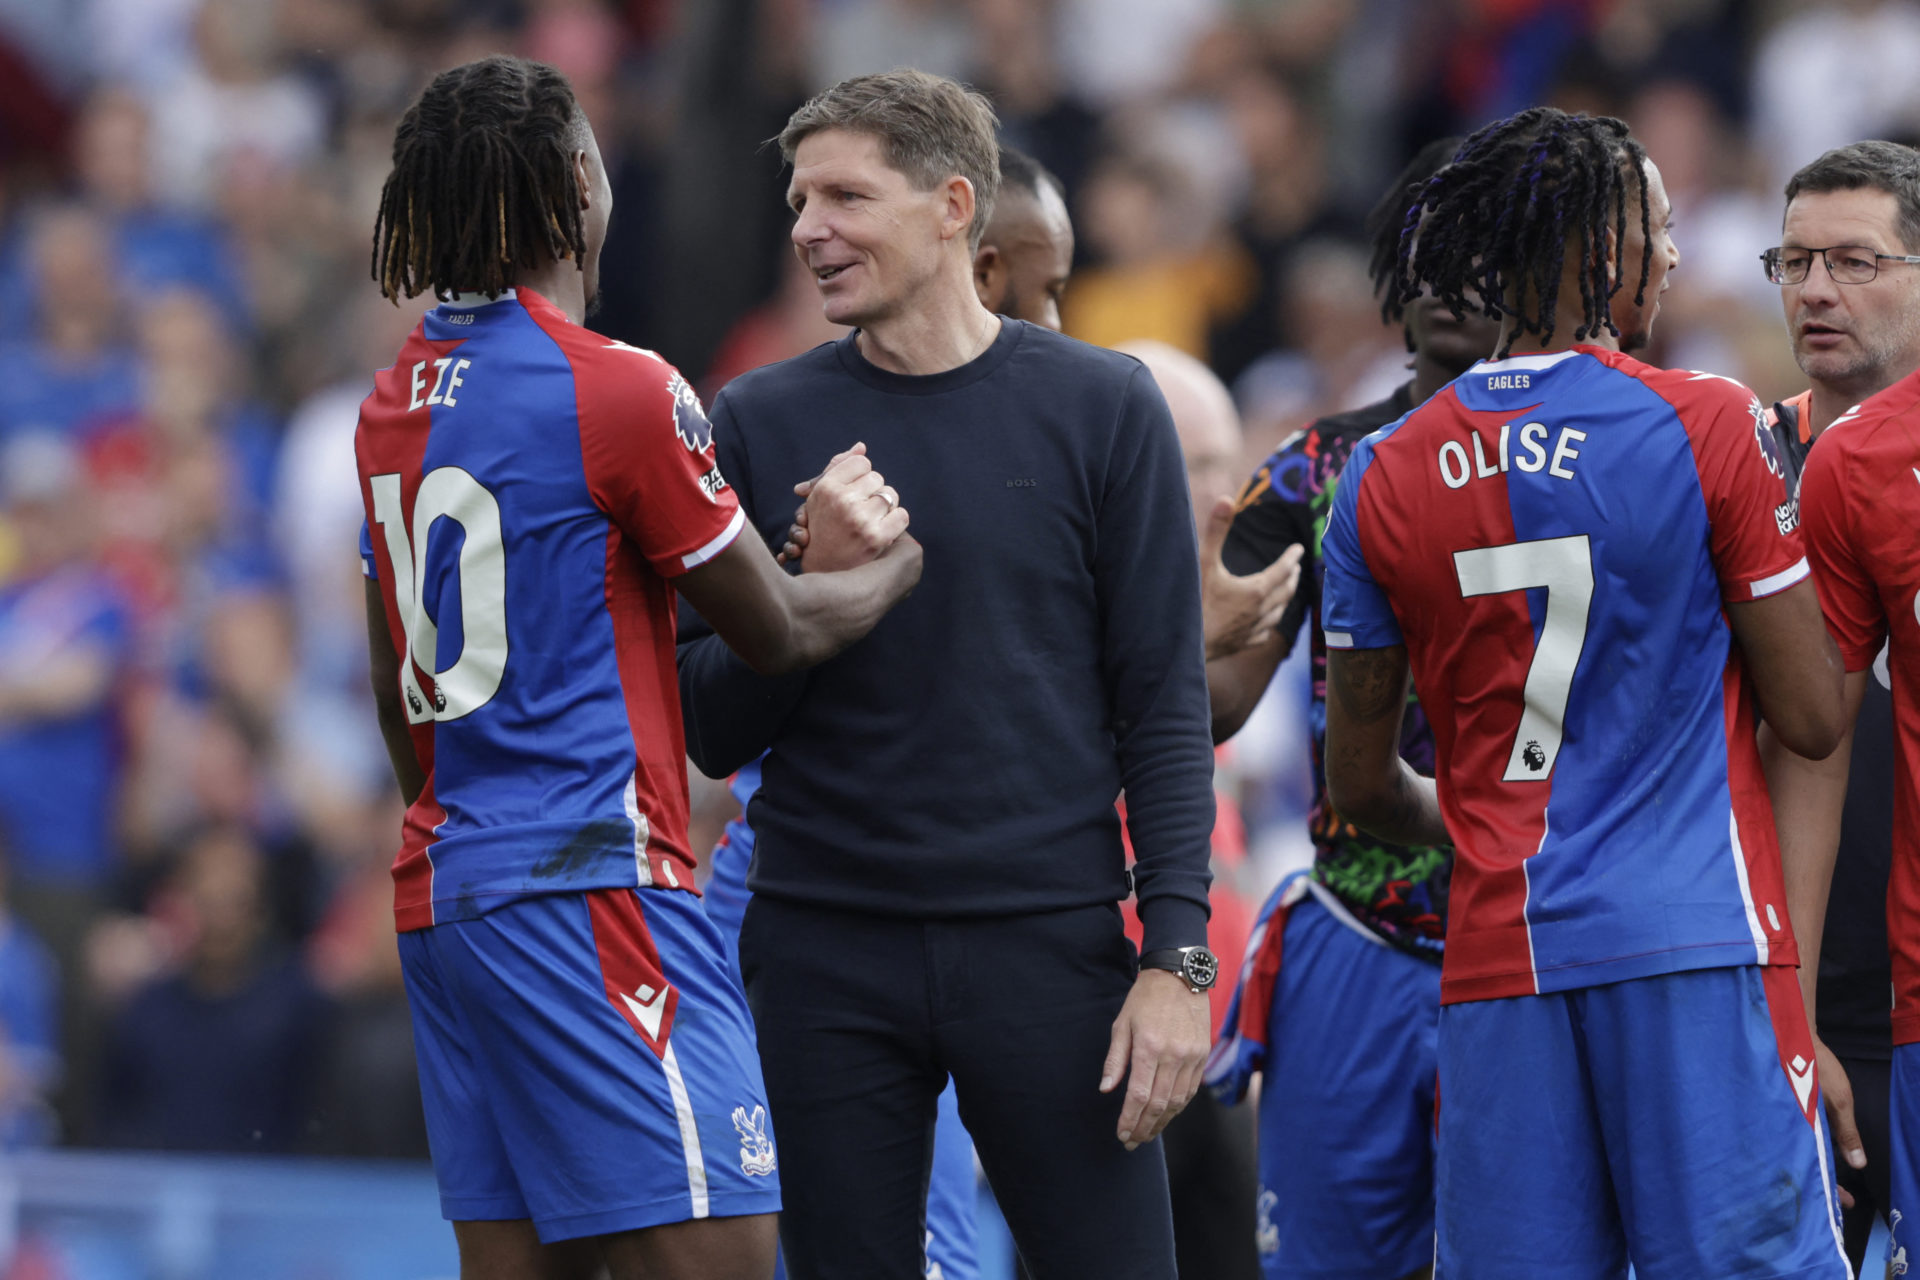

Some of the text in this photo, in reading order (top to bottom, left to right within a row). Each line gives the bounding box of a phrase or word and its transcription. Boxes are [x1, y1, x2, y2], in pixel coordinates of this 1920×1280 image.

[407, 357, 471, 413] EZE
[1488, 374, 1530, 391] EAGLES
[1006, 478, 1037, 488] BOSS
[1438, 422, 1588, 489] OLISE
[369, 465, 509, 726] 10
[1451, 533, 1595, 783] 7
